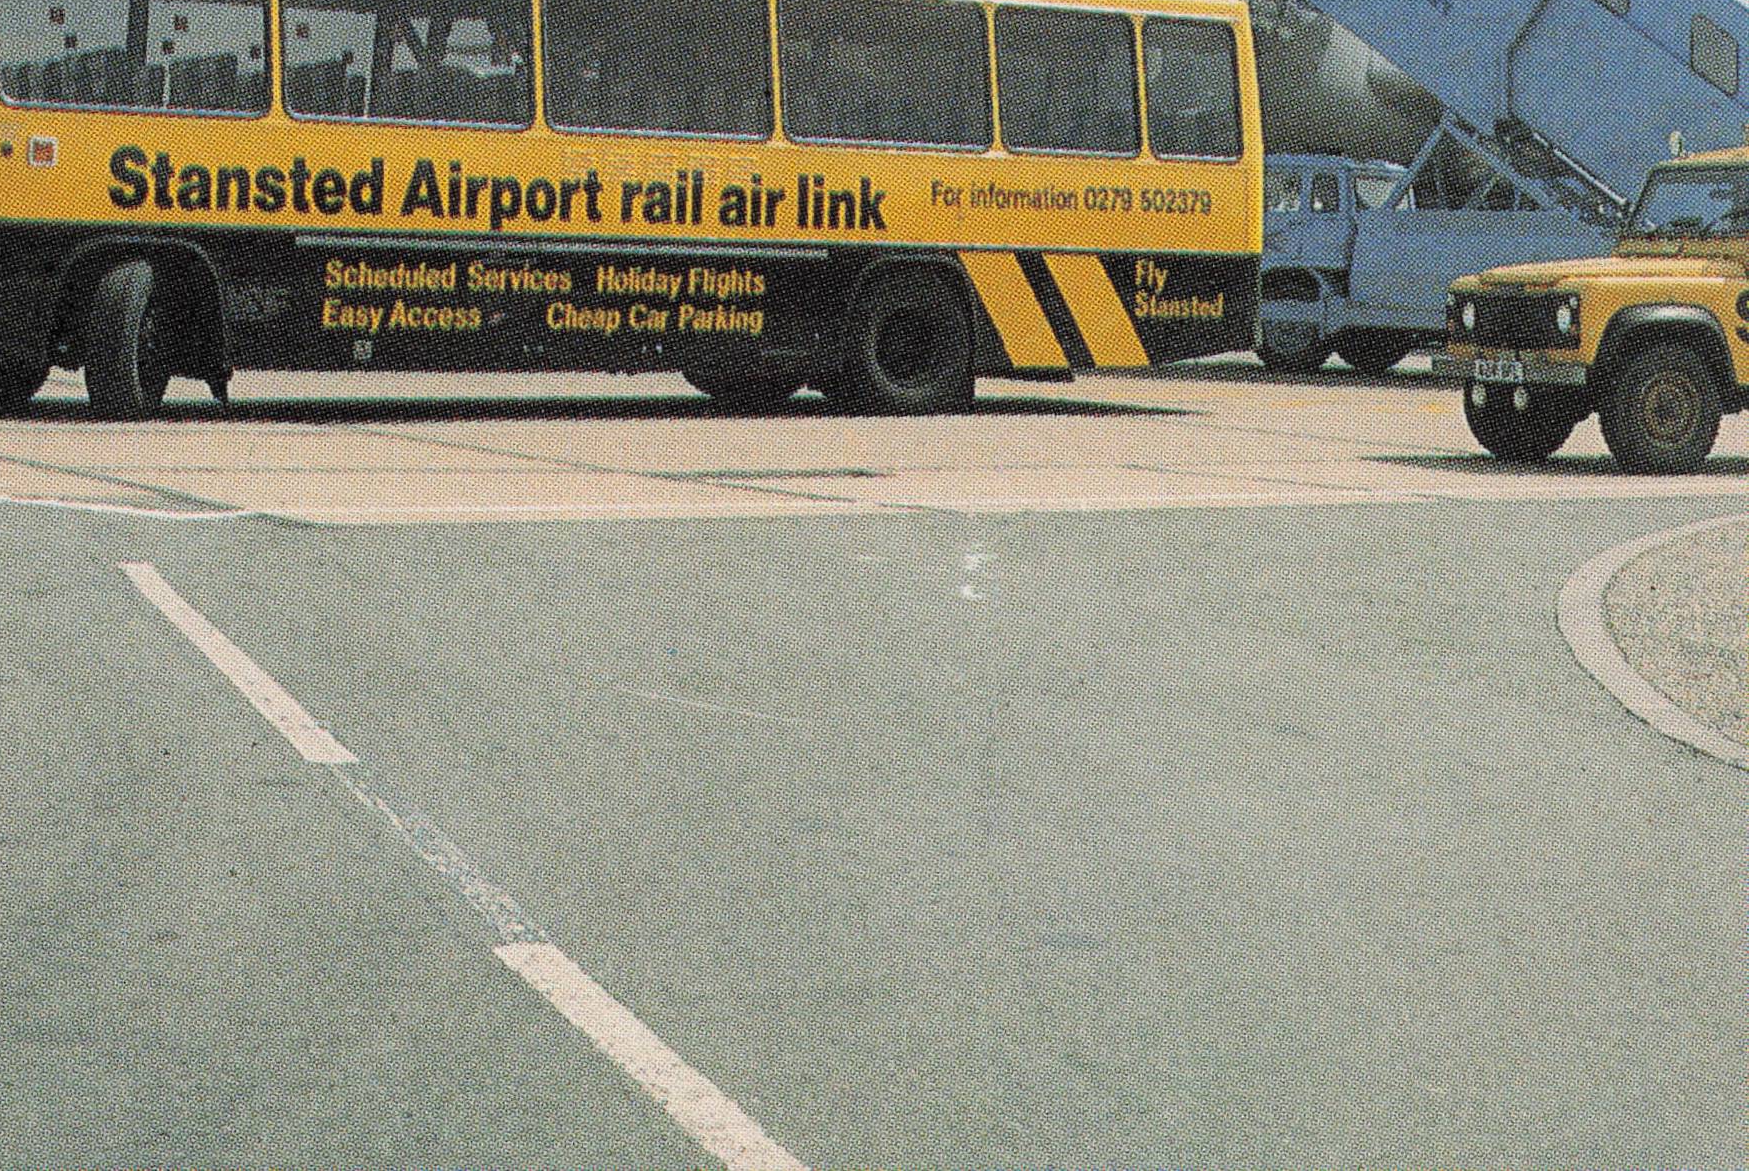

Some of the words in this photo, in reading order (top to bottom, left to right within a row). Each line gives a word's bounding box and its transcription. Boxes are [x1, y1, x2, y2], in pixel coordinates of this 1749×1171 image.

[108, 145, 384, 211] Stansted
[401, 158, 602, 229] Airport
[621, 170, 704, 225] rail
[718, 174, 785, 227] air
[797, 174, 886, 230] link
[930, 179, 962, 208] For
[969, 182, 1079, 211] information
[1083, 185, 1133, 213] 0279
[1139, 188, 1212, 216] 502379
[325, 261, 456, 290] Scheduled
[468, 261, 572, 292] Services
[596, 266, 682, 298] Holiday
[688, 267, 766, 299] Flights
[1135, 260, 1167, 291] Fly
[322, 299, 384, 332] Easy
[389, 300, 482, 329] Access
[546, 302, 621, 335] Cheap
[628, 306, 669, 331] Car
[678, 304, 764, 336] Parking
[1135, 291, 1224, 318] Stansted
